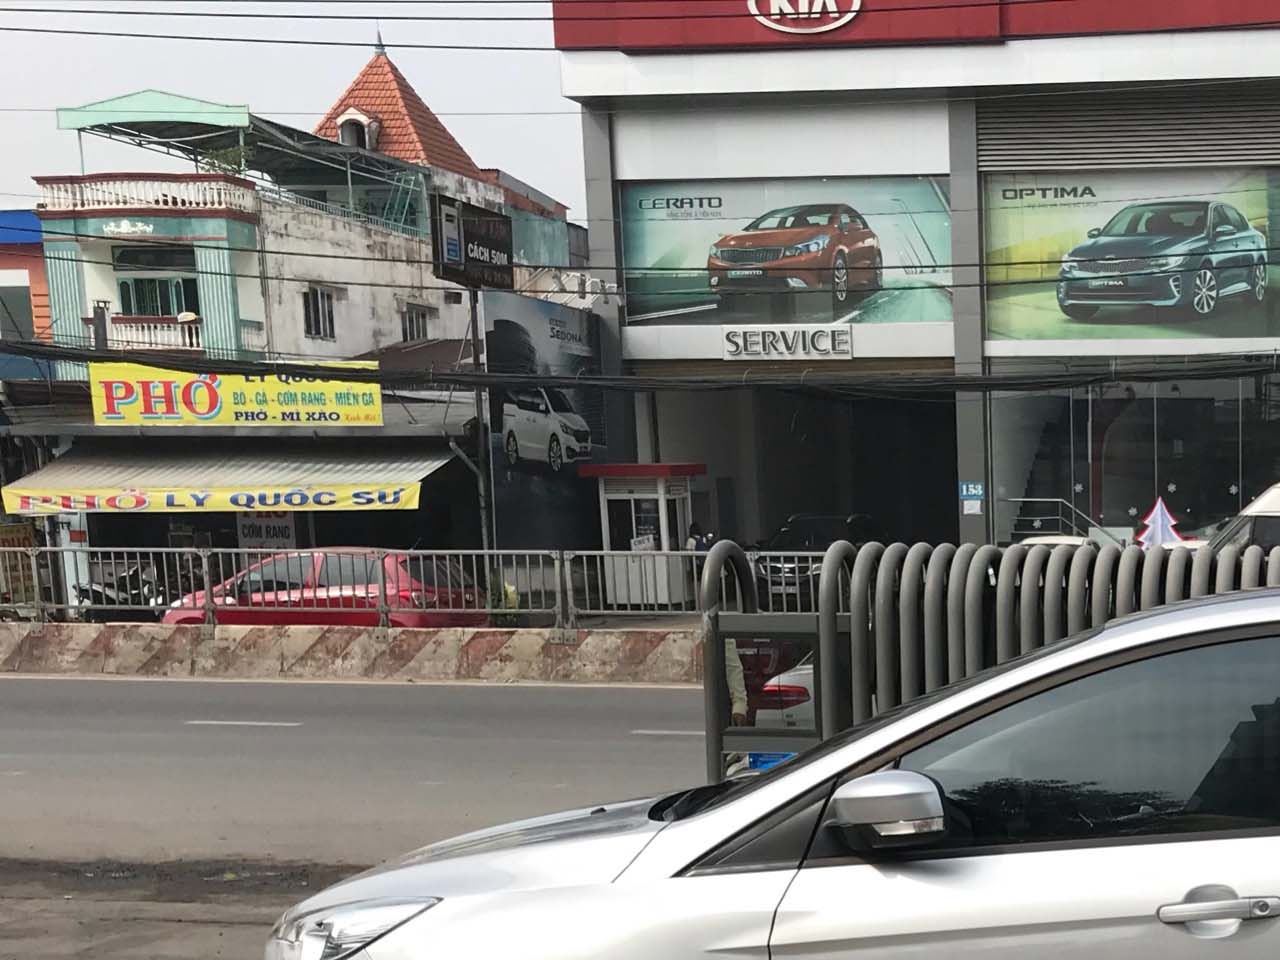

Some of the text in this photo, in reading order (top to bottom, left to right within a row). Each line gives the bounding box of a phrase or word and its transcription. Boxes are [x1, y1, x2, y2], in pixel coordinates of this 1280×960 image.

[1002, 186, 1096, 200] OPTIMA
[639, 196, 722, 210] CERATO
[468, 241, 490, 262] CÁCH
[550, 326, 582, 342] SEDONA
[725, 329, 851, 355] SERVICE
[99, 373, 222, 420] PHỞ
[301, 391, 327, 406] RANG
[229, 484, 336, 508] QUỐC
[352, 487, 403, 505] SƯ
[962, 484, 983, 496] 153
